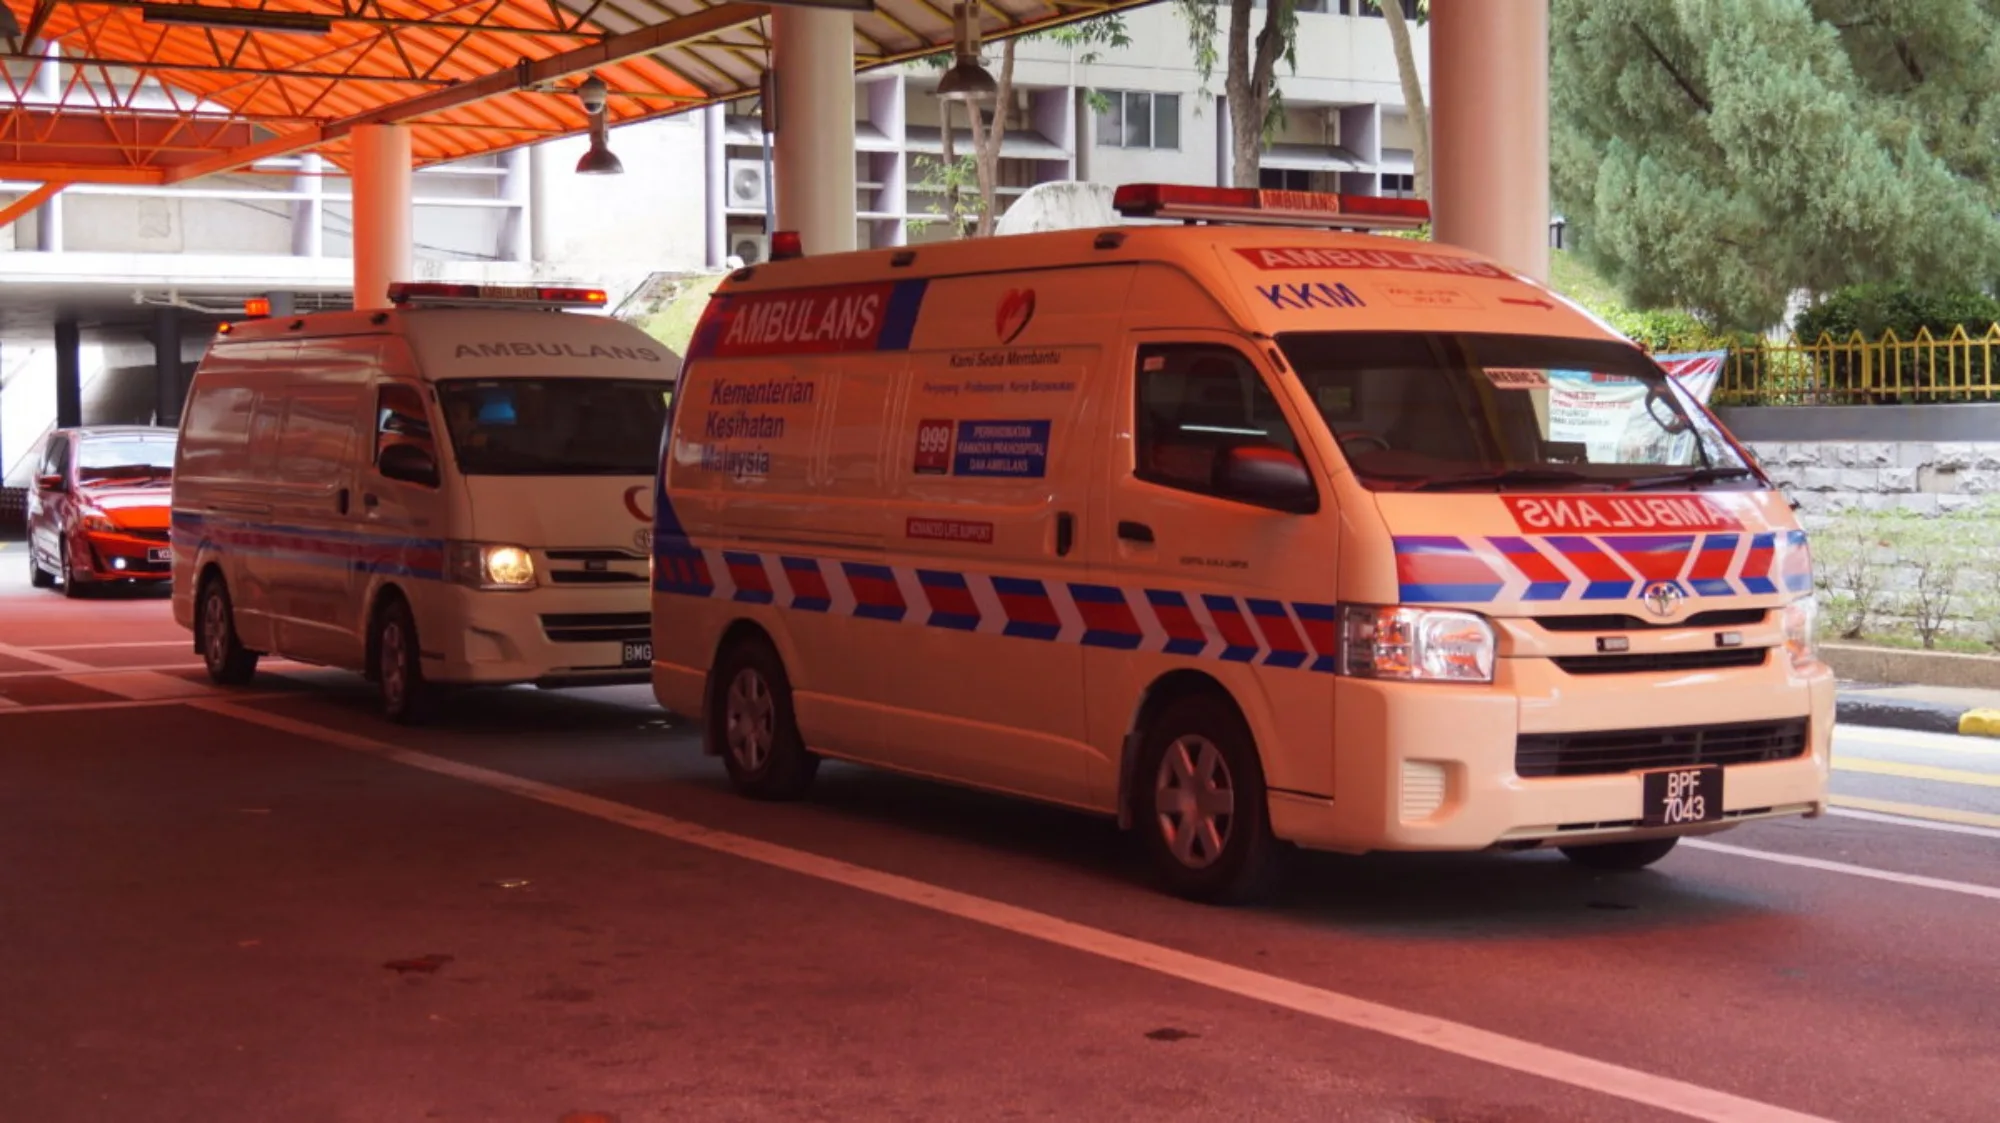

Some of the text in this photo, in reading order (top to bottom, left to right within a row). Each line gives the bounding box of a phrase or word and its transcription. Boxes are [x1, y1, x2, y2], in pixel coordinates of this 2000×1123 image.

[1263, 190, 1338, 212] AMBULANS
[1262, 249, 1498, 277] AMBULANS
[1256, 282, 1367, 310] KKM
[724, 293, 880, 345] AMBULANS
[455, 342, 661, 362] AMBULANS
[1006, 351, 1061, 366] Membantu
[710, 375, 815, 405] Kementerian
[705, 410, 785, 438] Kesihatan
[919, 426, 949, 453] 999
[700, 444, 770, 478] Malaysia
[624, 644, 653, 661] BMG
[1667, 771, 1701, 797] BPF
[1662, 796, 1705, 824] 7043
